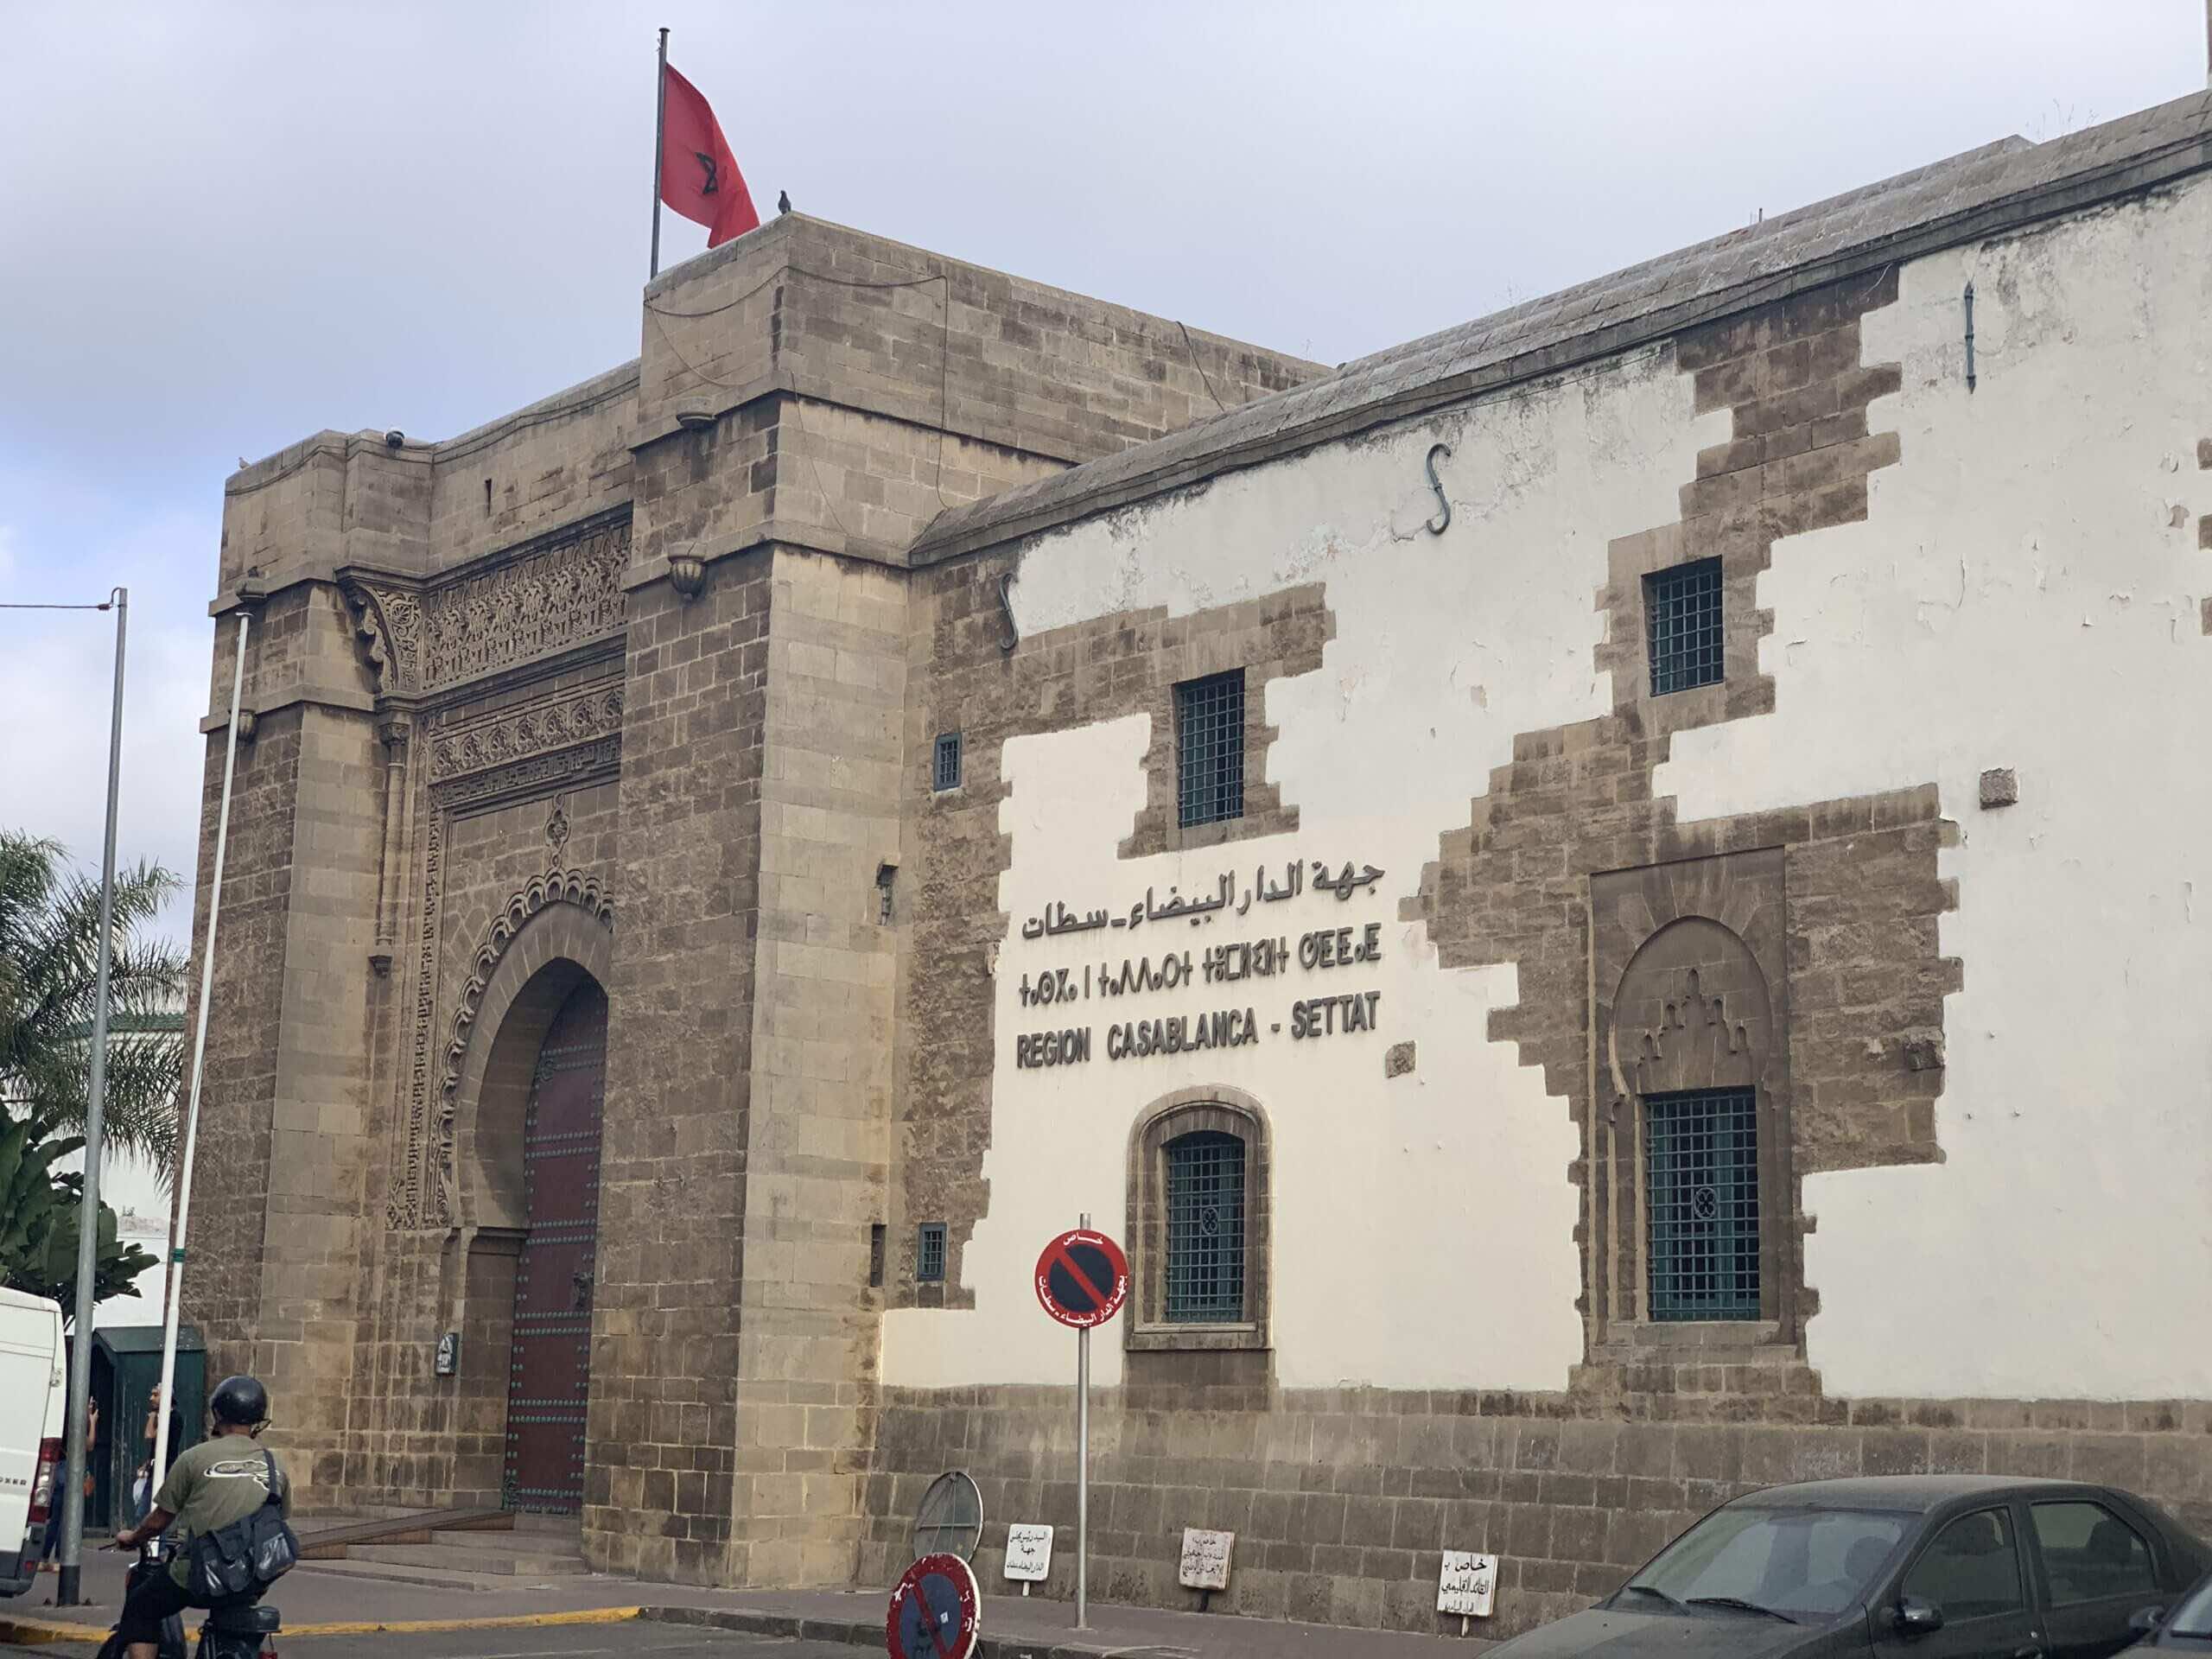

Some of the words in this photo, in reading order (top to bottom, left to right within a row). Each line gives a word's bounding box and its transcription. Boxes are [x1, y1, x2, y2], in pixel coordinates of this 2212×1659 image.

[1236, 858, 1304, 916] الدار
[1312, 861, 1386, 900] جهة
[1017, 1027, 1091, 1069] REGION
[1107, 1007, 1259, 1060] CASABLANCA
[1291, 990, 1382, 1039] SETTAT
[1063, 1232, 1103, 1245] خاص
[1455, 1554, 1487, 1572] خاص
